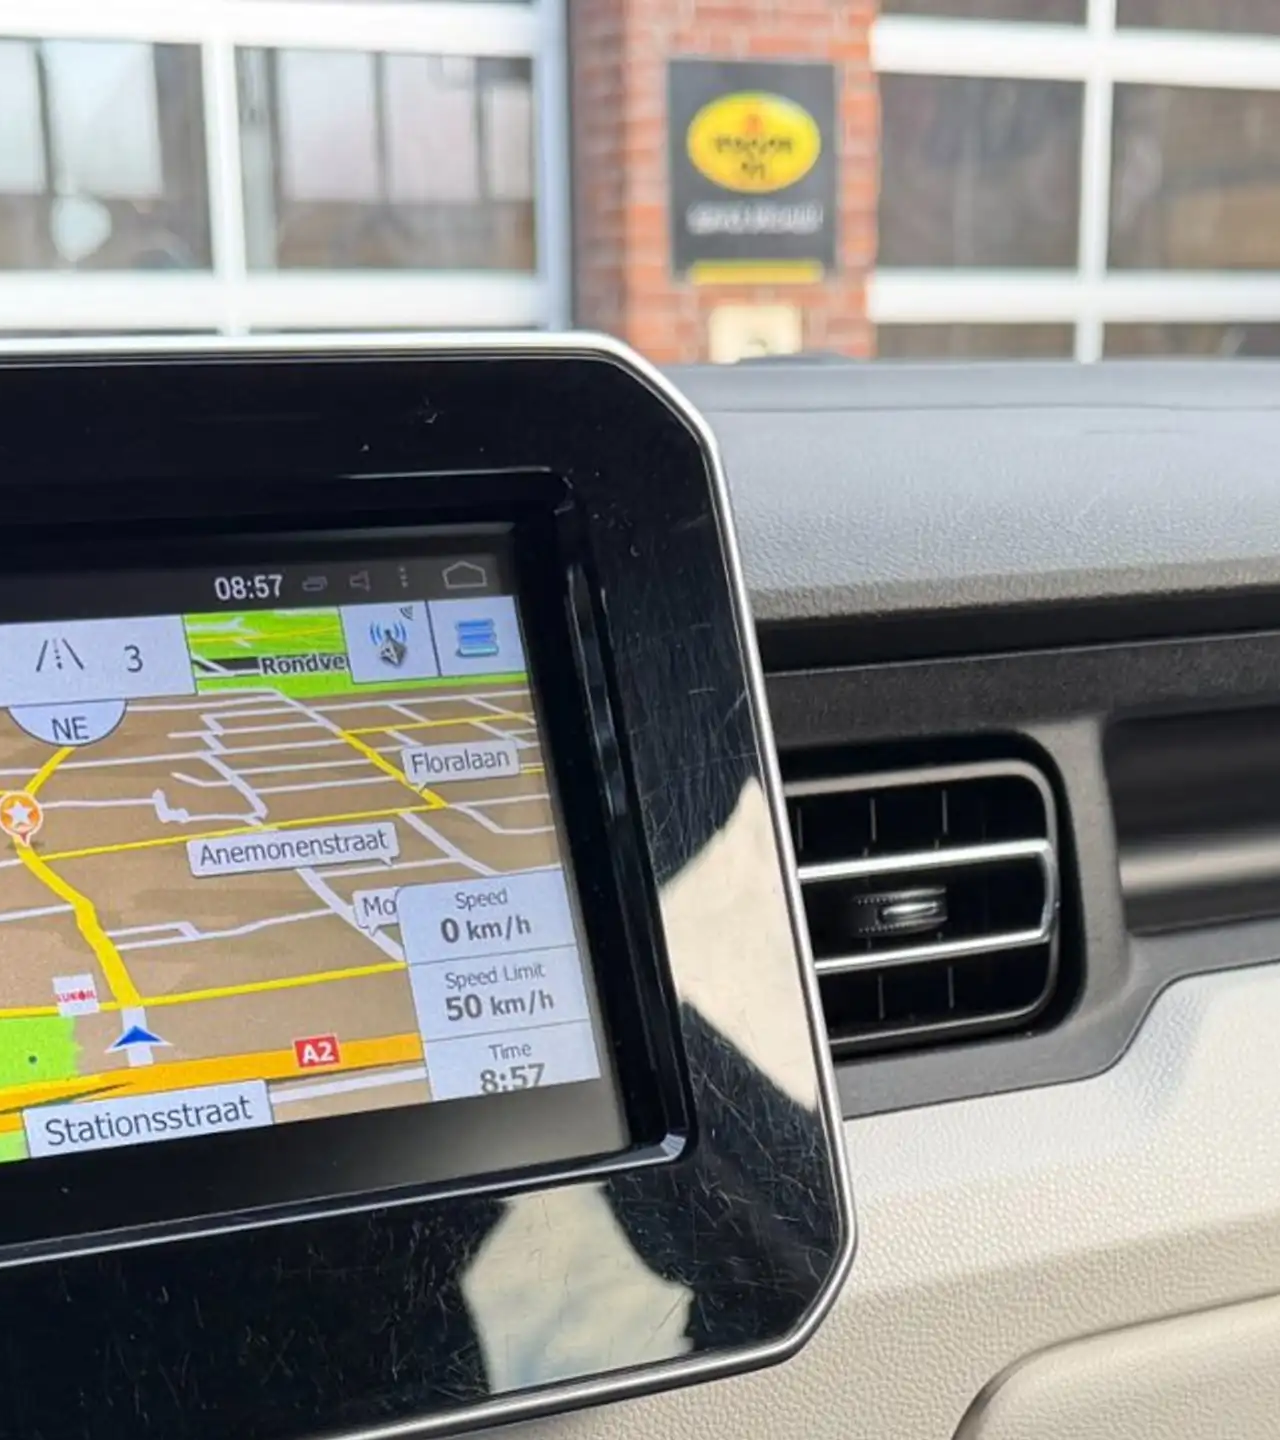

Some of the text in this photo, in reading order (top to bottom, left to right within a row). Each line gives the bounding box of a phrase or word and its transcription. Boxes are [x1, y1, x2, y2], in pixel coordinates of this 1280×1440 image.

[214, 574, 283, 600] 08:57
[125, 646, 144, 674] 3
[52, 716, 89, 742] NE
[412, 747, 510, 775] Floralaan
[199, 829, 389, 868] Anemonenstraat
[454, 888, 508, 911] Speed
[440, 915, 531, 943] 0 km/h
[445, 962, 546, 992] Speed Limit
[445, 990, 554, 1021] 50 km/h
[301, 1041, 335, 1066] A2
[488, 1043, 532, 1062] Time
[480, 1063, 546, 1094] 8:57
[45, 1095, 252, 1147] Stationsstraat
